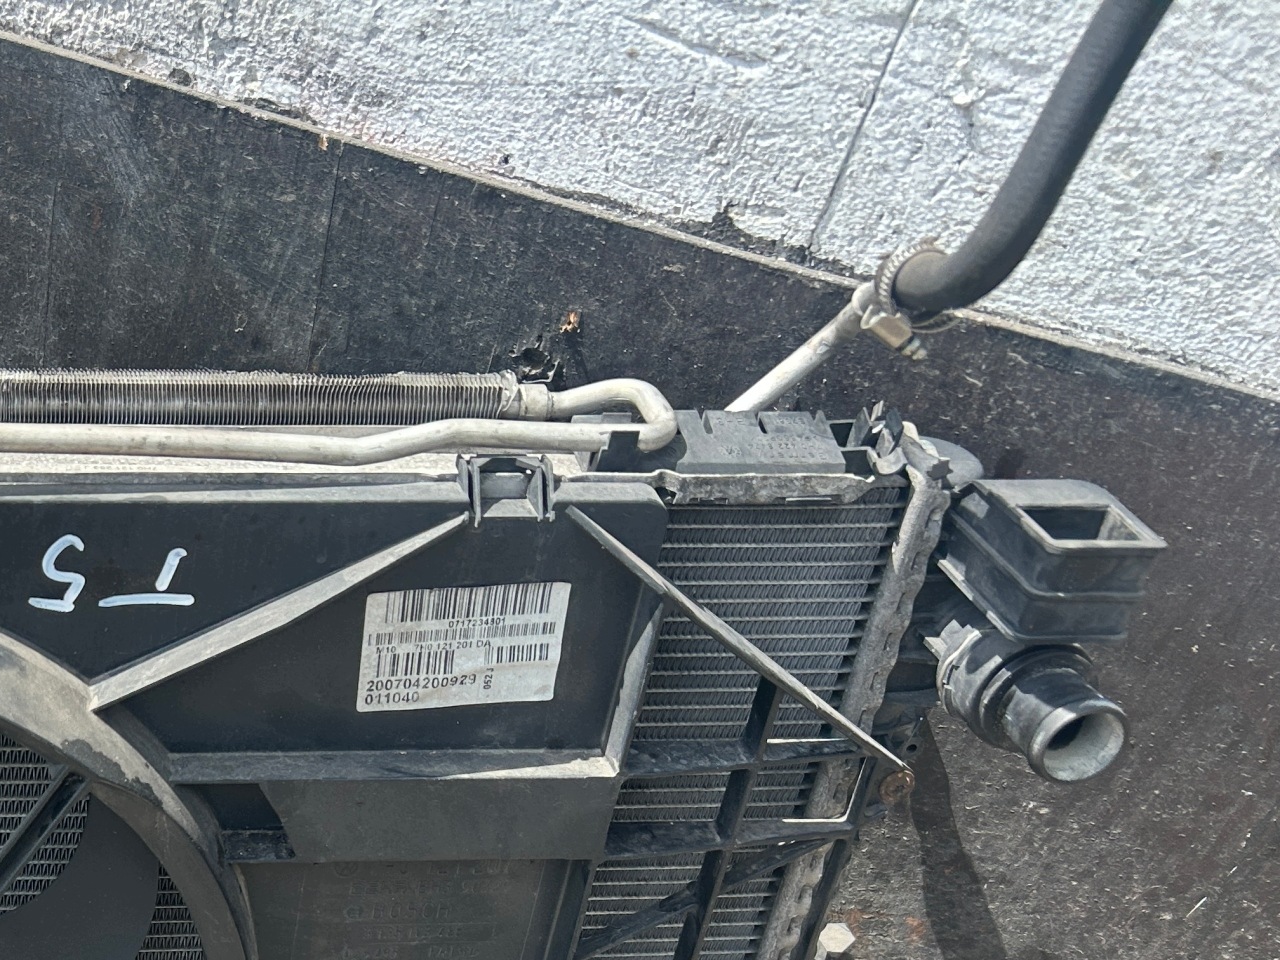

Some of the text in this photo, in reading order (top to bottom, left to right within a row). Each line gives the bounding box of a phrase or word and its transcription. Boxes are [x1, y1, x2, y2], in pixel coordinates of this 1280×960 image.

[437, 642, 453, 650] 121
[476, 640, 491, 648] DA
[366, 673, 476, 691] 200704200929
[483, 673, 493, 690] 052
[364, 692, 420, 706] 011040
[372, 902, 453, 920] BOSCH
